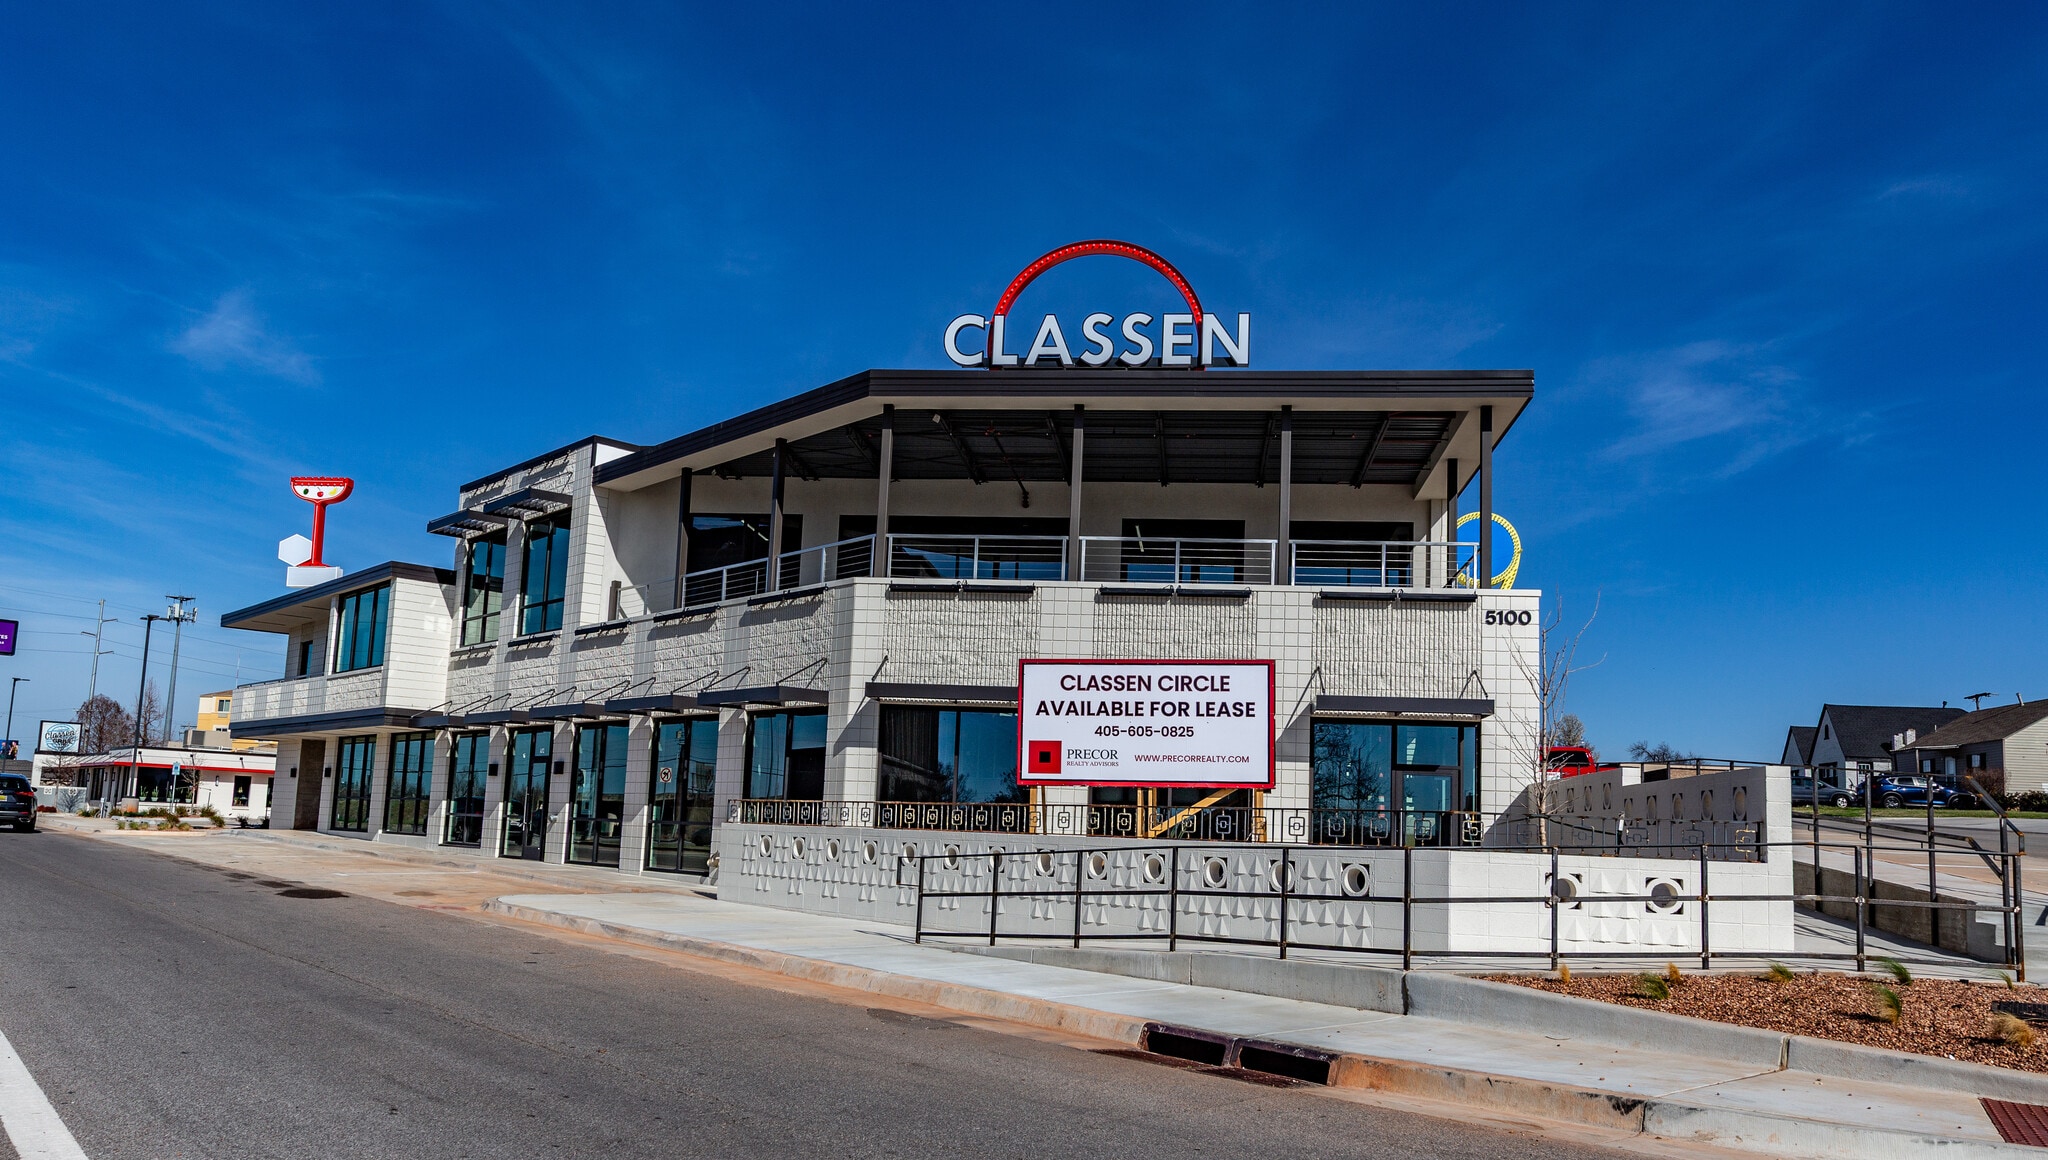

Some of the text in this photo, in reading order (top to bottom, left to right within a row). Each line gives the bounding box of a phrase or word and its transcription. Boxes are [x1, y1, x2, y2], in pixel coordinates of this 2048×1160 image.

[943, 312, 1250, 367] CLASSEN
[1485, 610, 1532, 626] 5100
[1060, 674, 1230, 692] CLASSEN CIRCLE
[1035, 700, 1256, 718] AVAILABLE FOR LEASE
[1094, 725, 1194, 737] 405-605-0825
[1067, 748, 1119, 760] PRECOR
[1134, 754, 1250, 763] WWW.PRECORREALTY.COM
